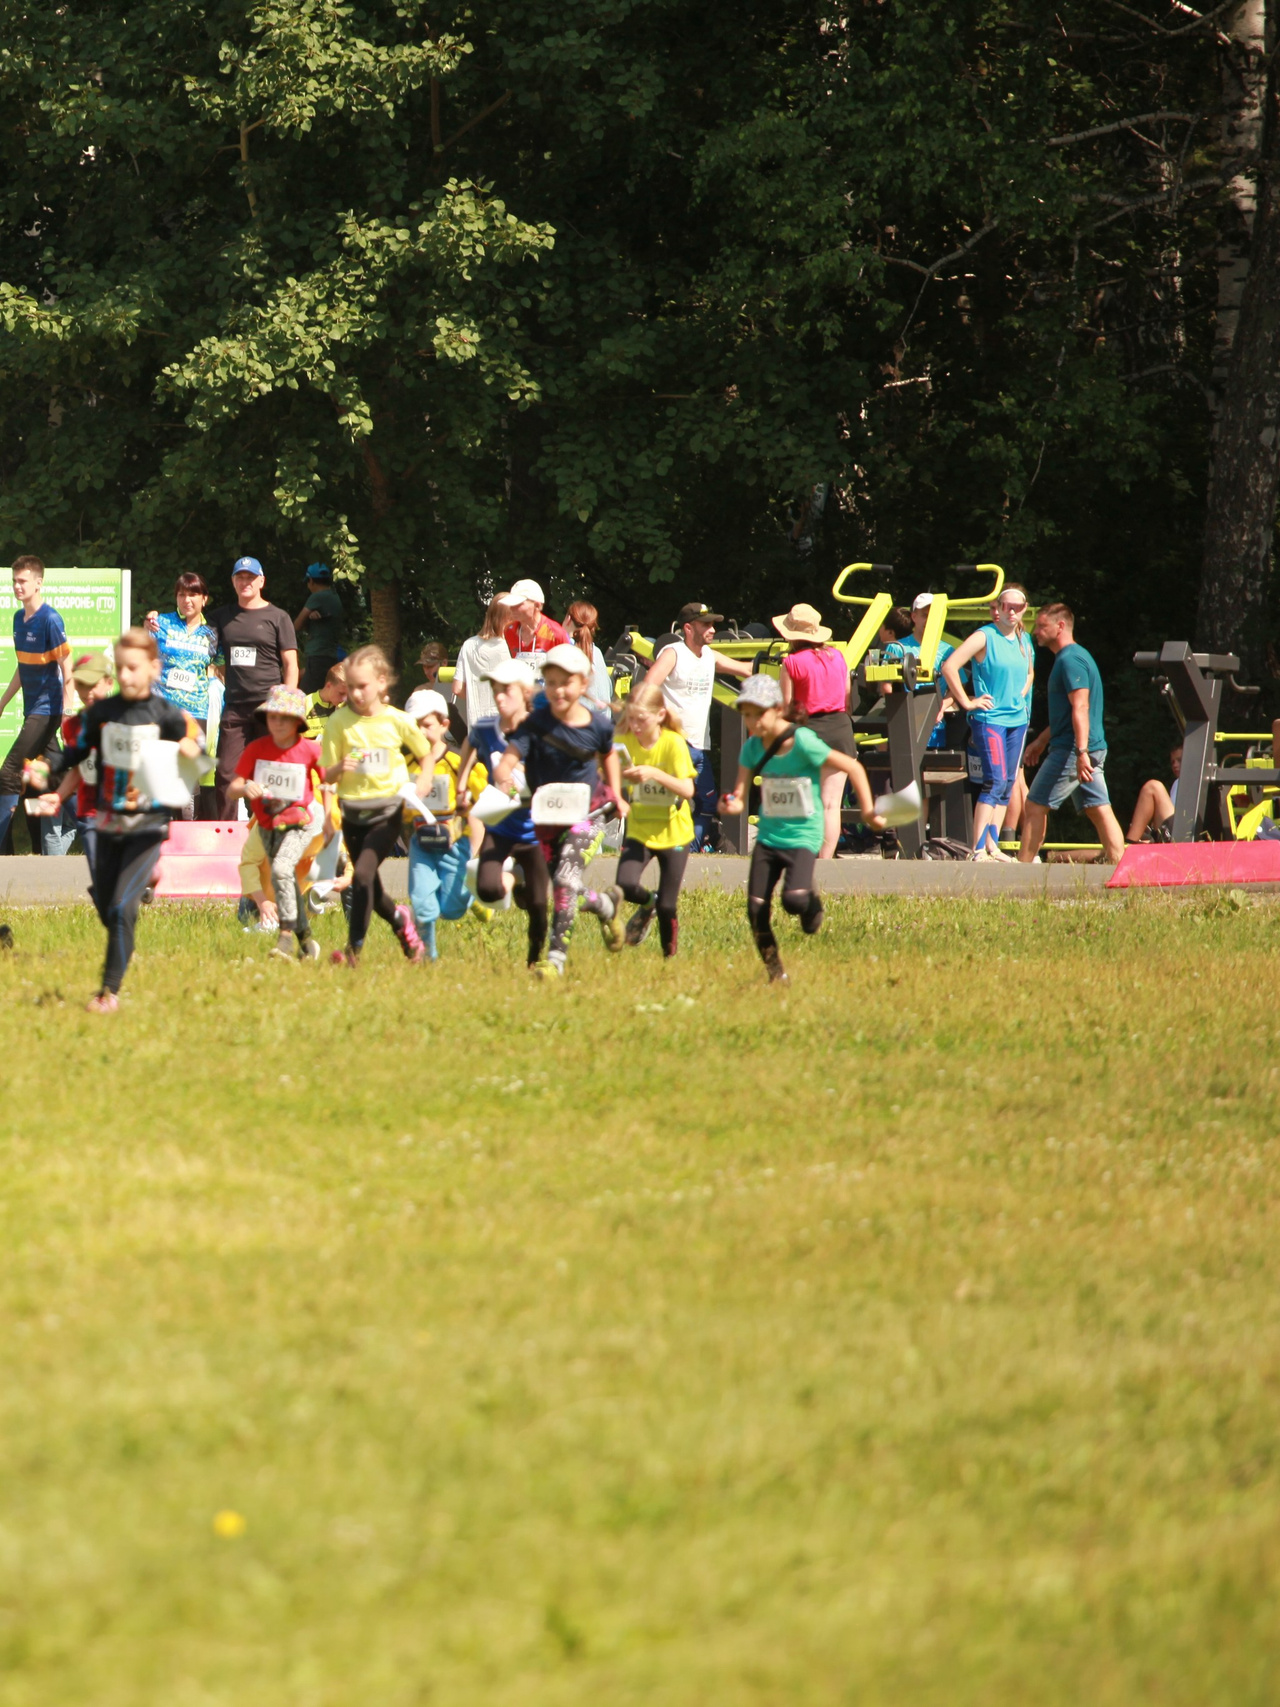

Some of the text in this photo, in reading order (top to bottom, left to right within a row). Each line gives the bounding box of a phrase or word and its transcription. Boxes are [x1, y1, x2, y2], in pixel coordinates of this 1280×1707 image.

[54, 596, 95, 609] ОБОРОНЕ»
[96, 596, 116, 612] (ГТО)
[234, 649, 251, 658] 832
[173, 672, 190, 683] 909
[972, 764, 982, 772] 97
[267, 774, 291, 788] 601
[644, 784, 666, 795] 614
[772, 792, 795, 804] 607
